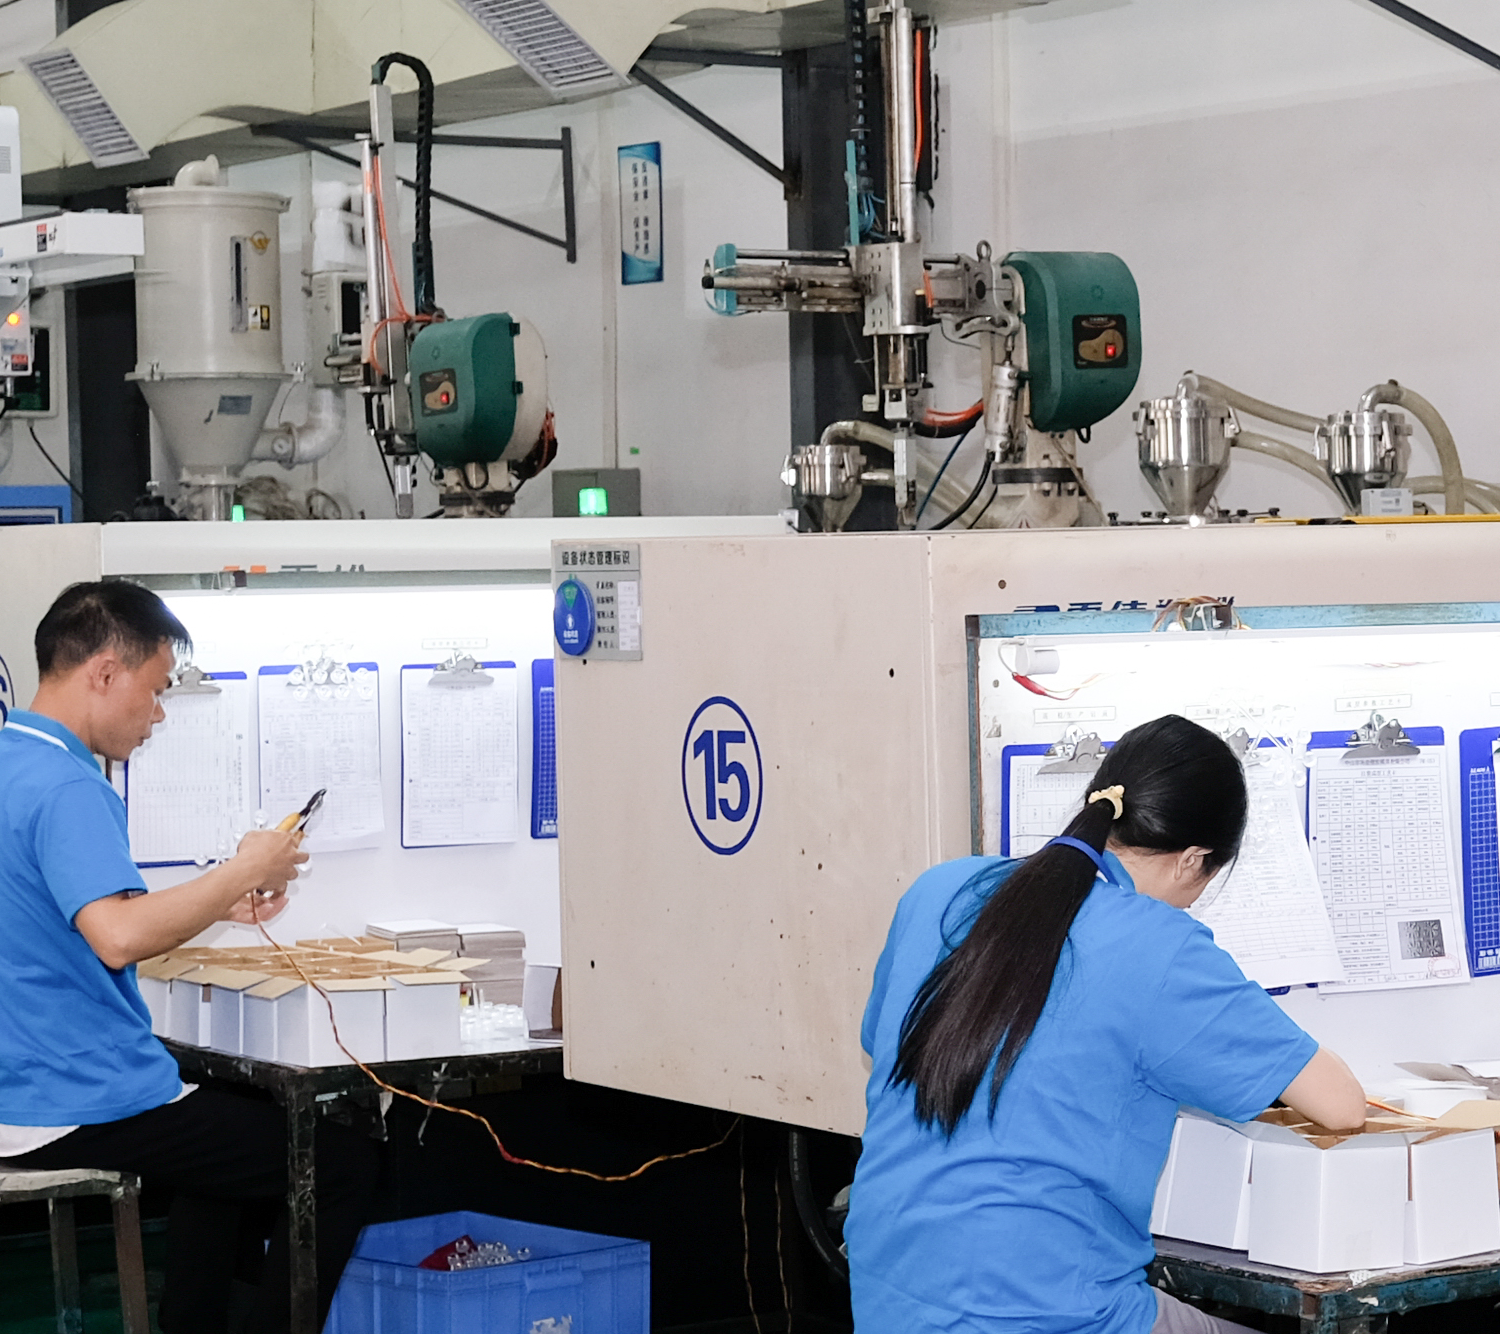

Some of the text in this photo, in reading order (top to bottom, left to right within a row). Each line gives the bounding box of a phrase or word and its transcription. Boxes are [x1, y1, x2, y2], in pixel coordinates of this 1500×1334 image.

[561, 550, 631, 566] 设备状态管理标识
[692, 729, 752, 824] 15
